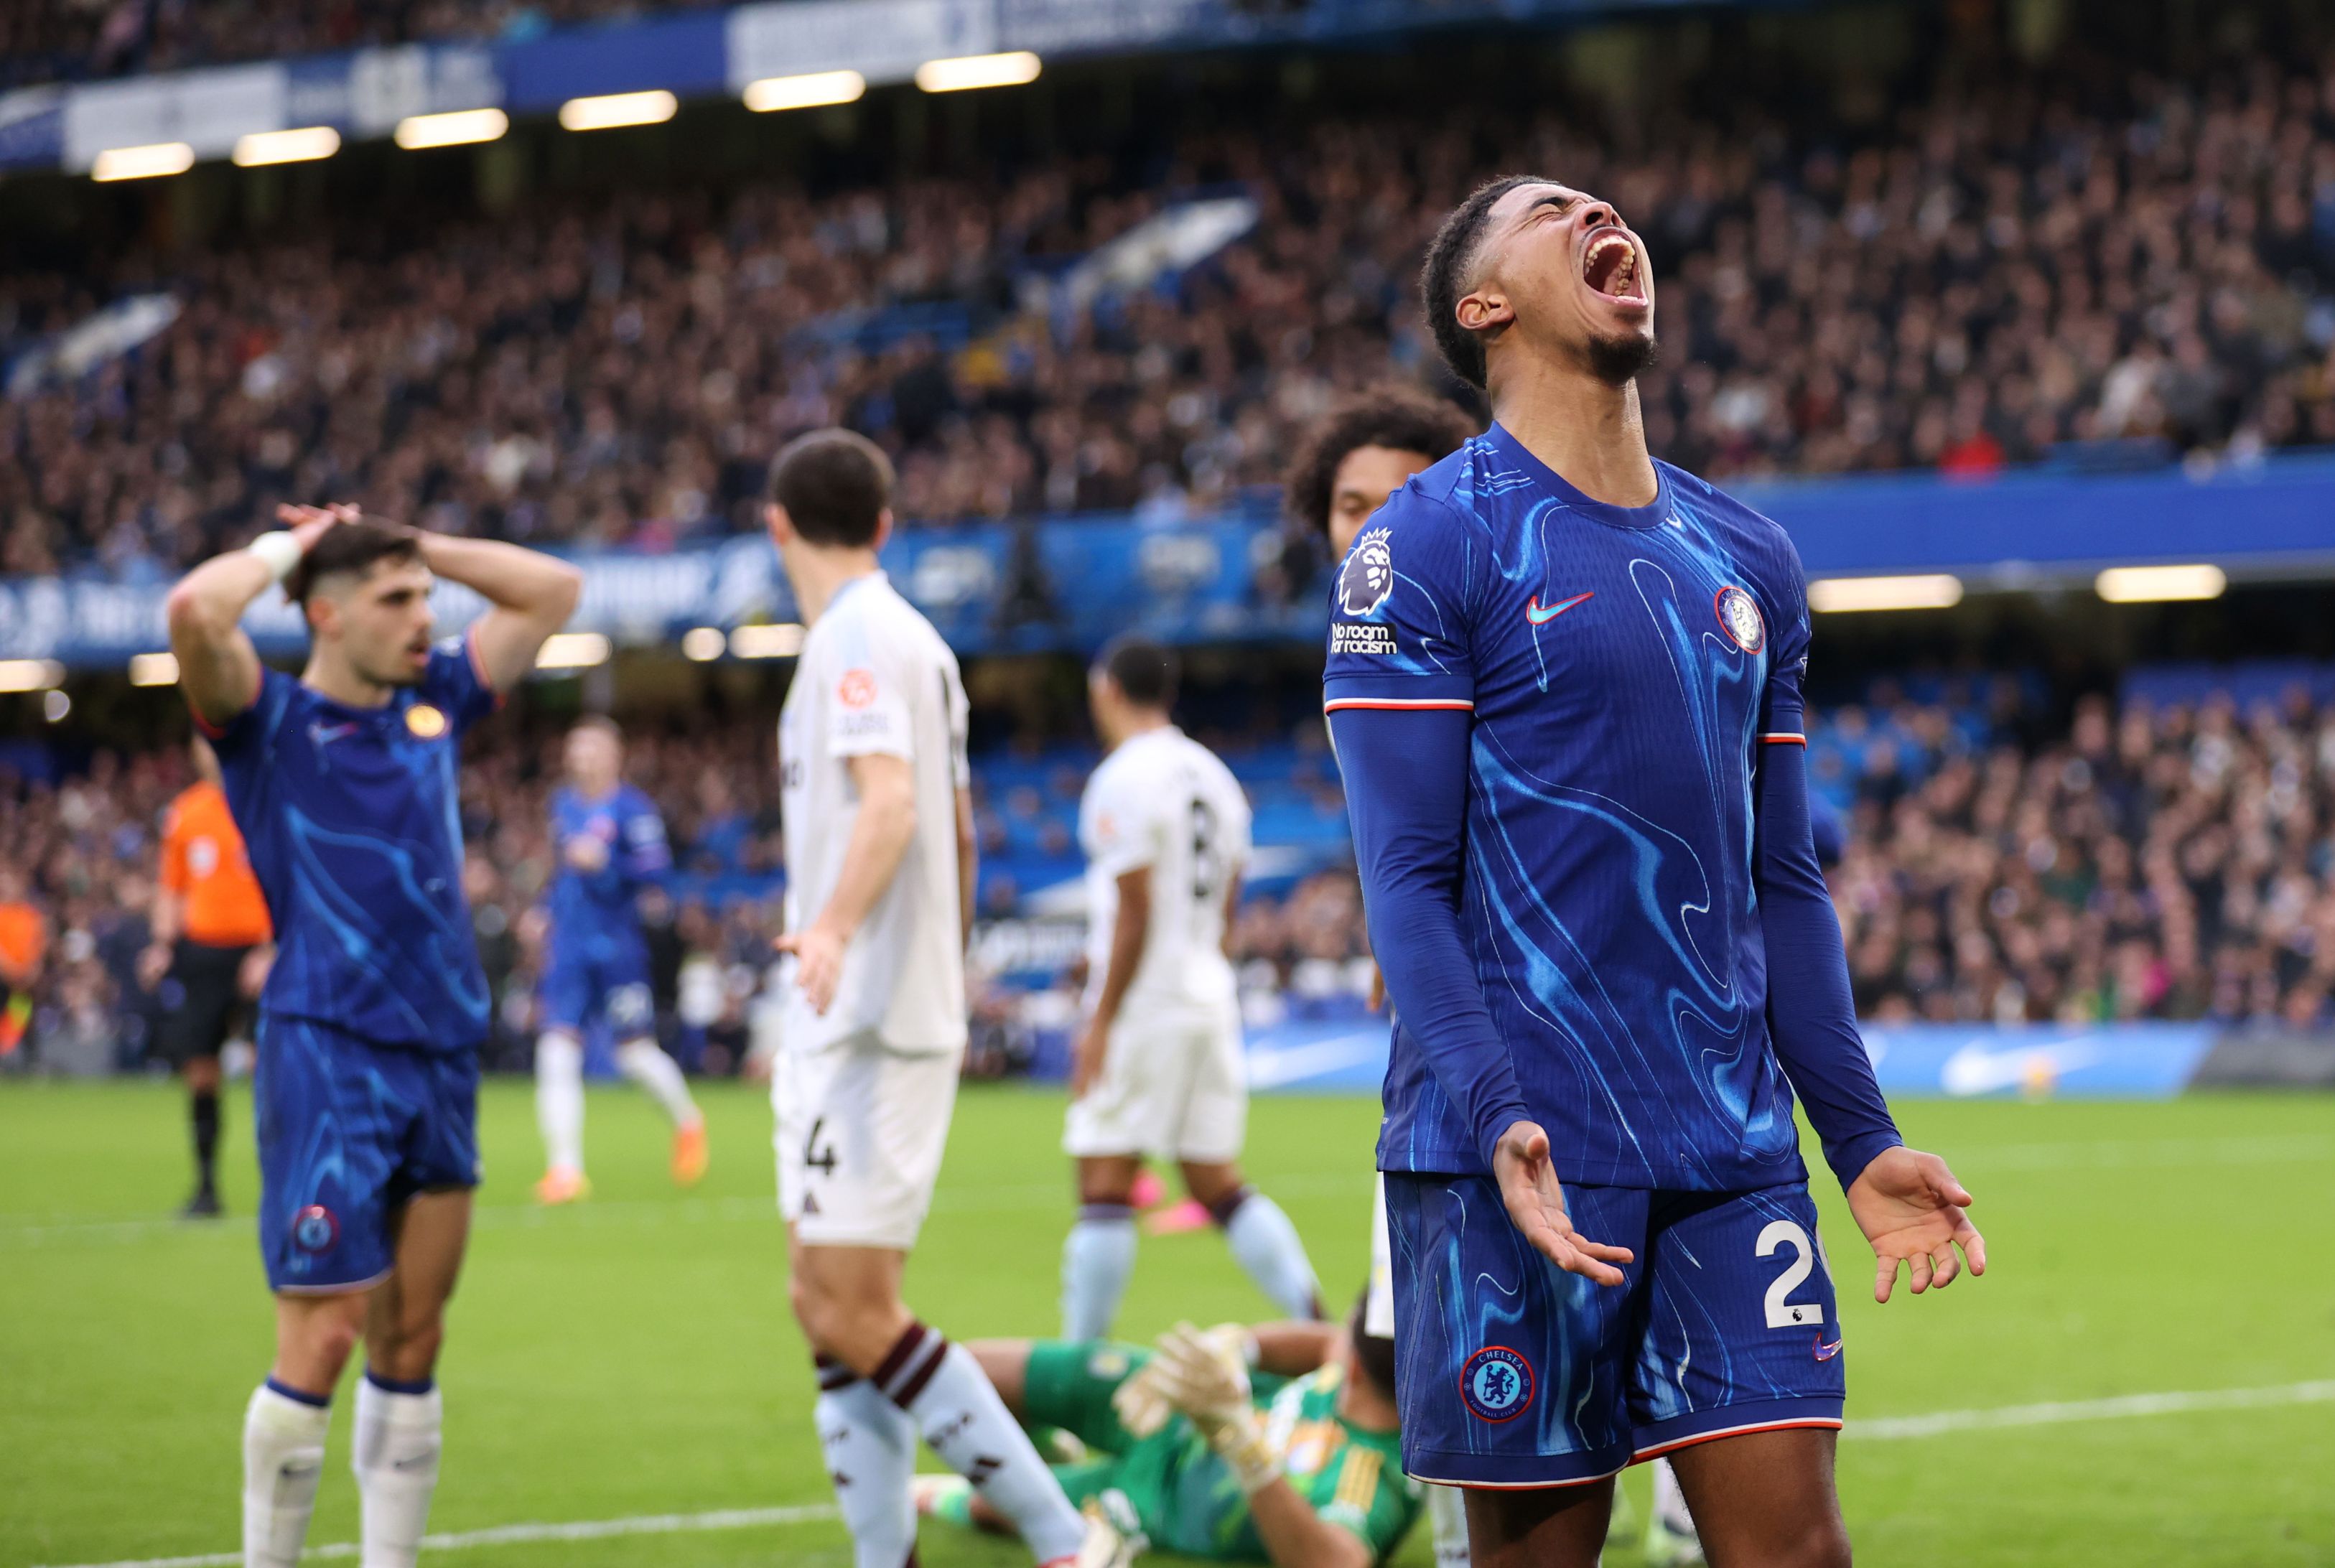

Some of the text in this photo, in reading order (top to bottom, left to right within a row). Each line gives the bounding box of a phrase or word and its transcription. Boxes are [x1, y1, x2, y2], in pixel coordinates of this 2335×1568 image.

[1332, 623, 1388, 640] No room
[1331, 639, 1397, 654] for racism
[806, 1116, 837, 1177] 4
[1478, 1350, 1524, 1371] CHELSEA
[1470, 1399, 1517, 1418] FOOTBALL CLUB
